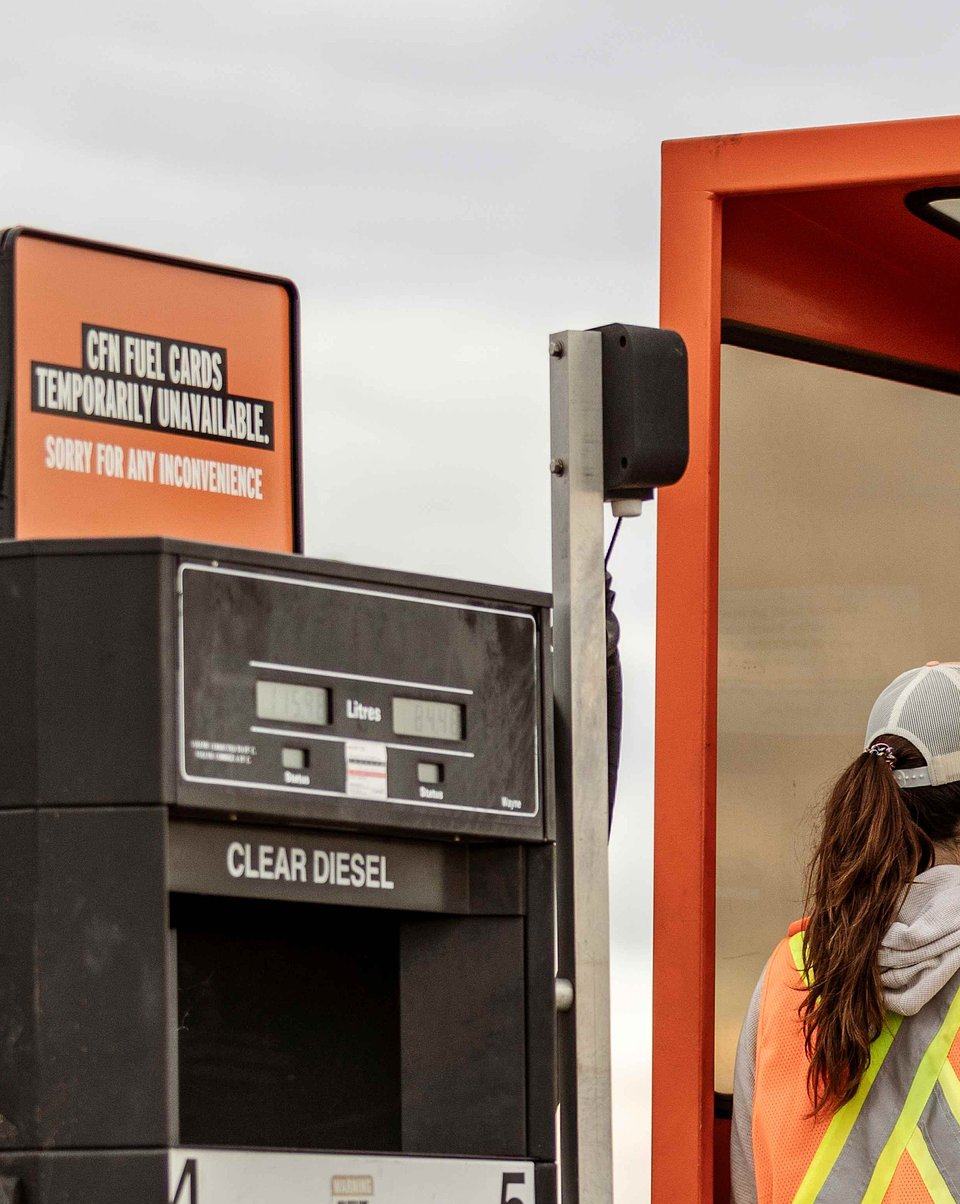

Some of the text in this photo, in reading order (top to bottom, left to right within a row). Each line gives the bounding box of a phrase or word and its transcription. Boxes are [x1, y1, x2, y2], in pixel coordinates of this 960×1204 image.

[86, 329, 222, 392] CFN FUEL CARDS
[35, 366, 270, 444] TEMPORARILY UNAVAILABLE.
[44, 434, 263, 500] SORRY FOR ANY INCONVENIENCE
[346, 700, 382, 722] Litres
[420, 786, 444, 800] Status
[501, 796, 522, 810] Wayne
[226, 841, 394, 890] CLEAR DIESEL
